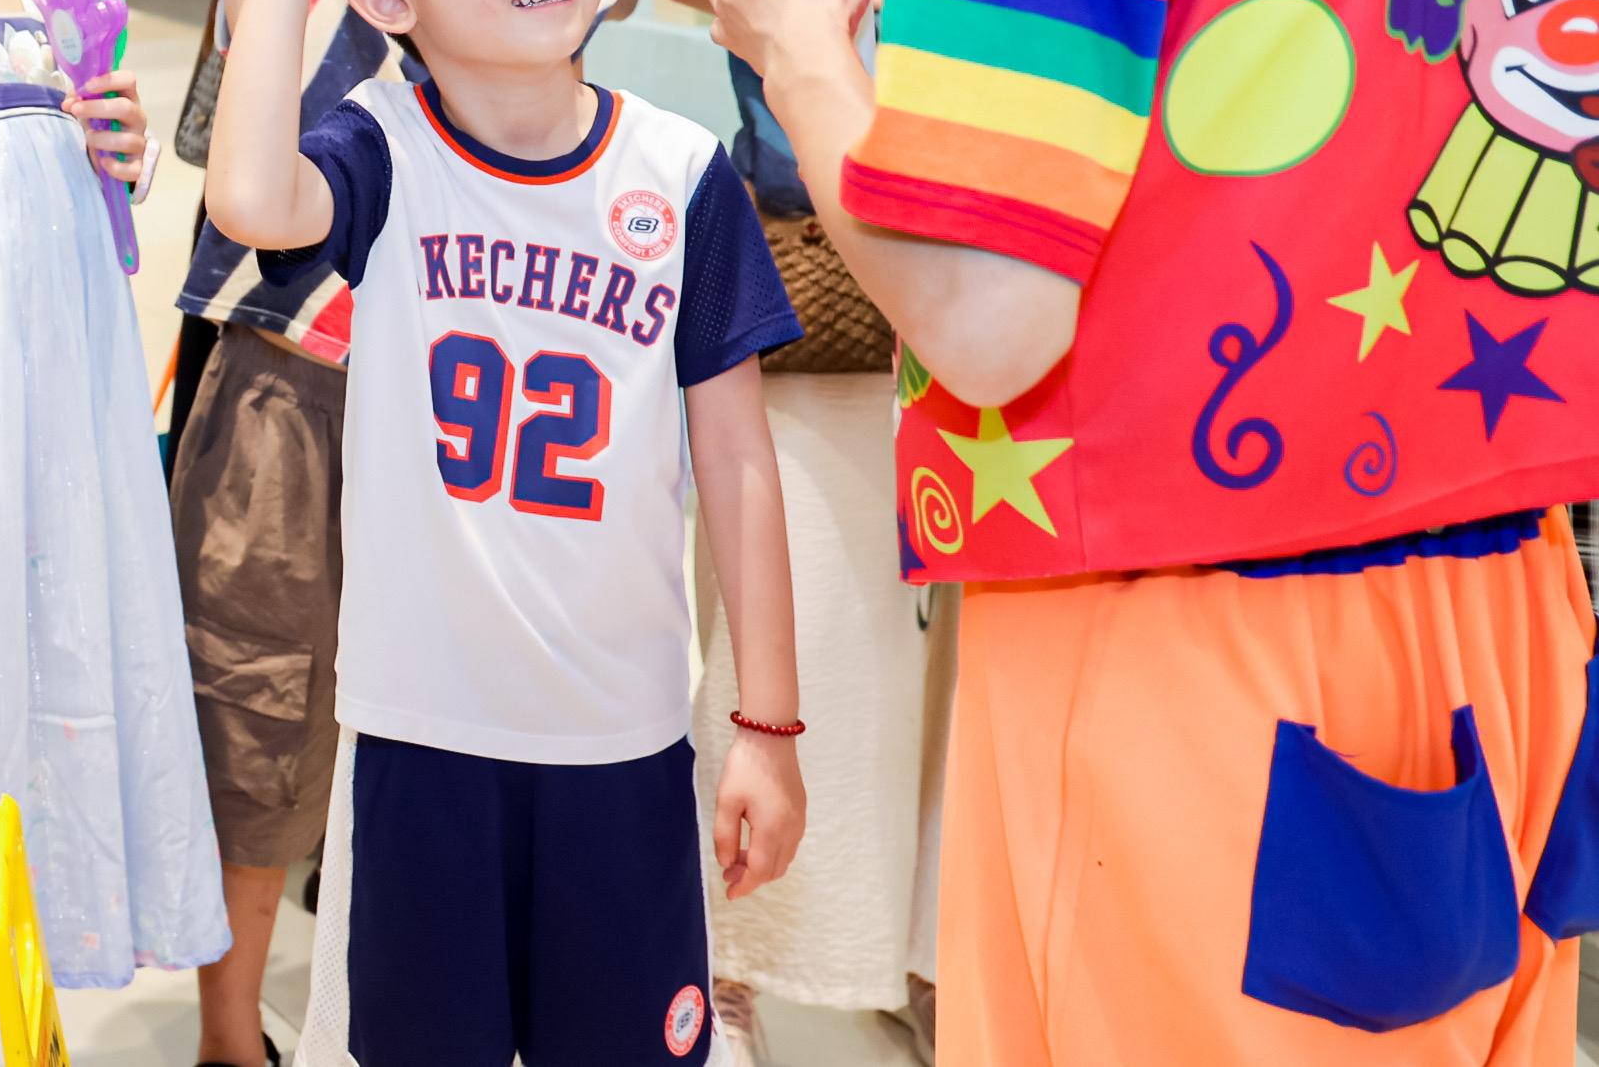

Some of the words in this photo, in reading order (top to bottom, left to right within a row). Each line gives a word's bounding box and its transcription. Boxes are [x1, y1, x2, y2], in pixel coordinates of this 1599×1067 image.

[616, 193, 668, 212] SKECHERS
[418, 233, 676, 348] KECHERS
[428, 330, 612, 522] 92
